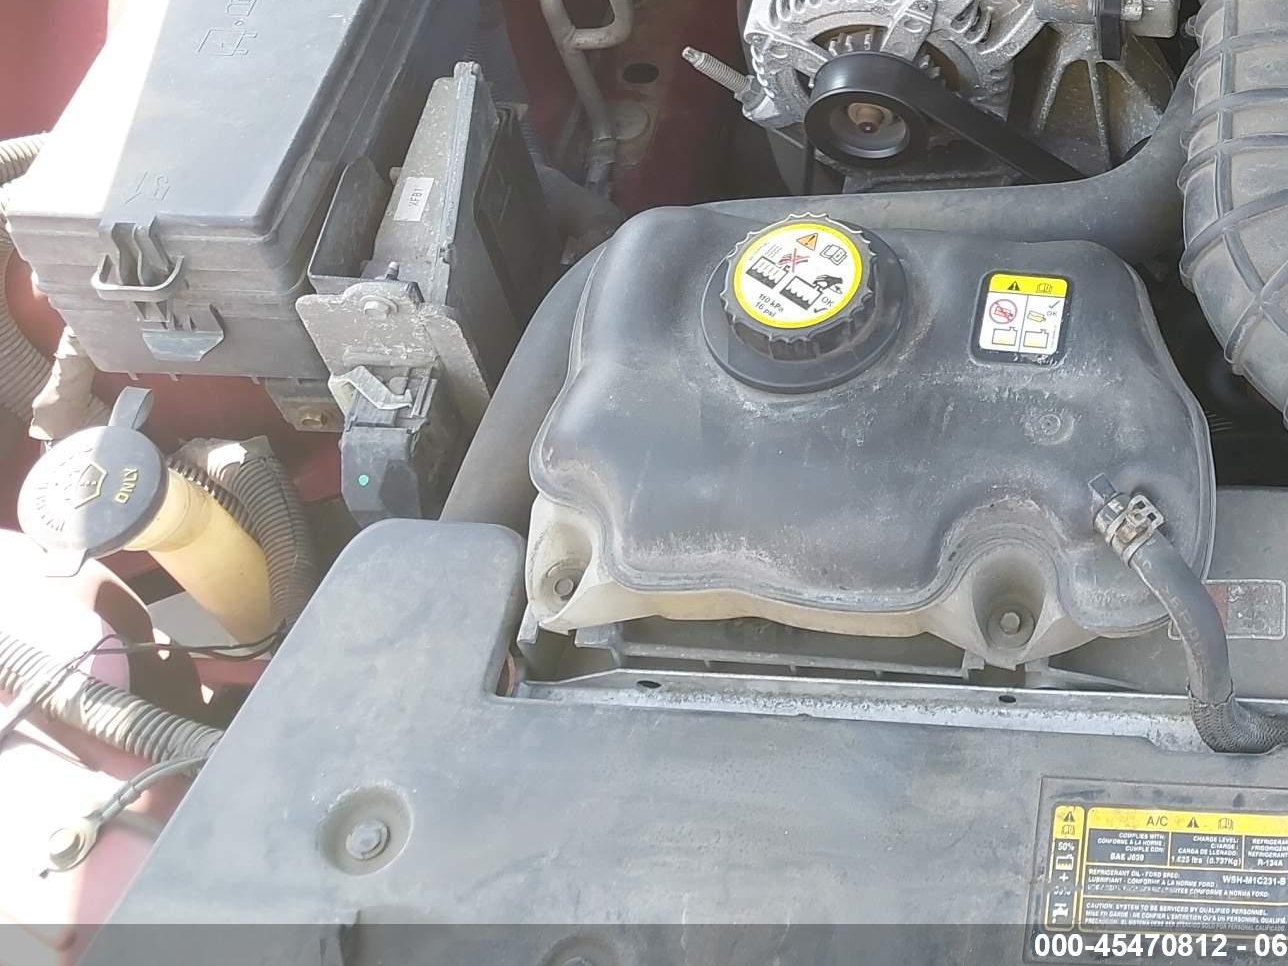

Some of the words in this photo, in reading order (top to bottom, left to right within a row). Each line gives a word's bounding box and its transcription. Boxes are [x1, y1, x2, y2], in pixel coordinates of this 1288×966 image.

[759, 294, 771, 304] 110
[769, 300, 784, 312] kPa
[821, 296, 834, 307] OK
[113, 467, 139, 504] ONLY
[1146, 816, 1168, 827] A/C
[1058, 842, 1075, 851] 50%
